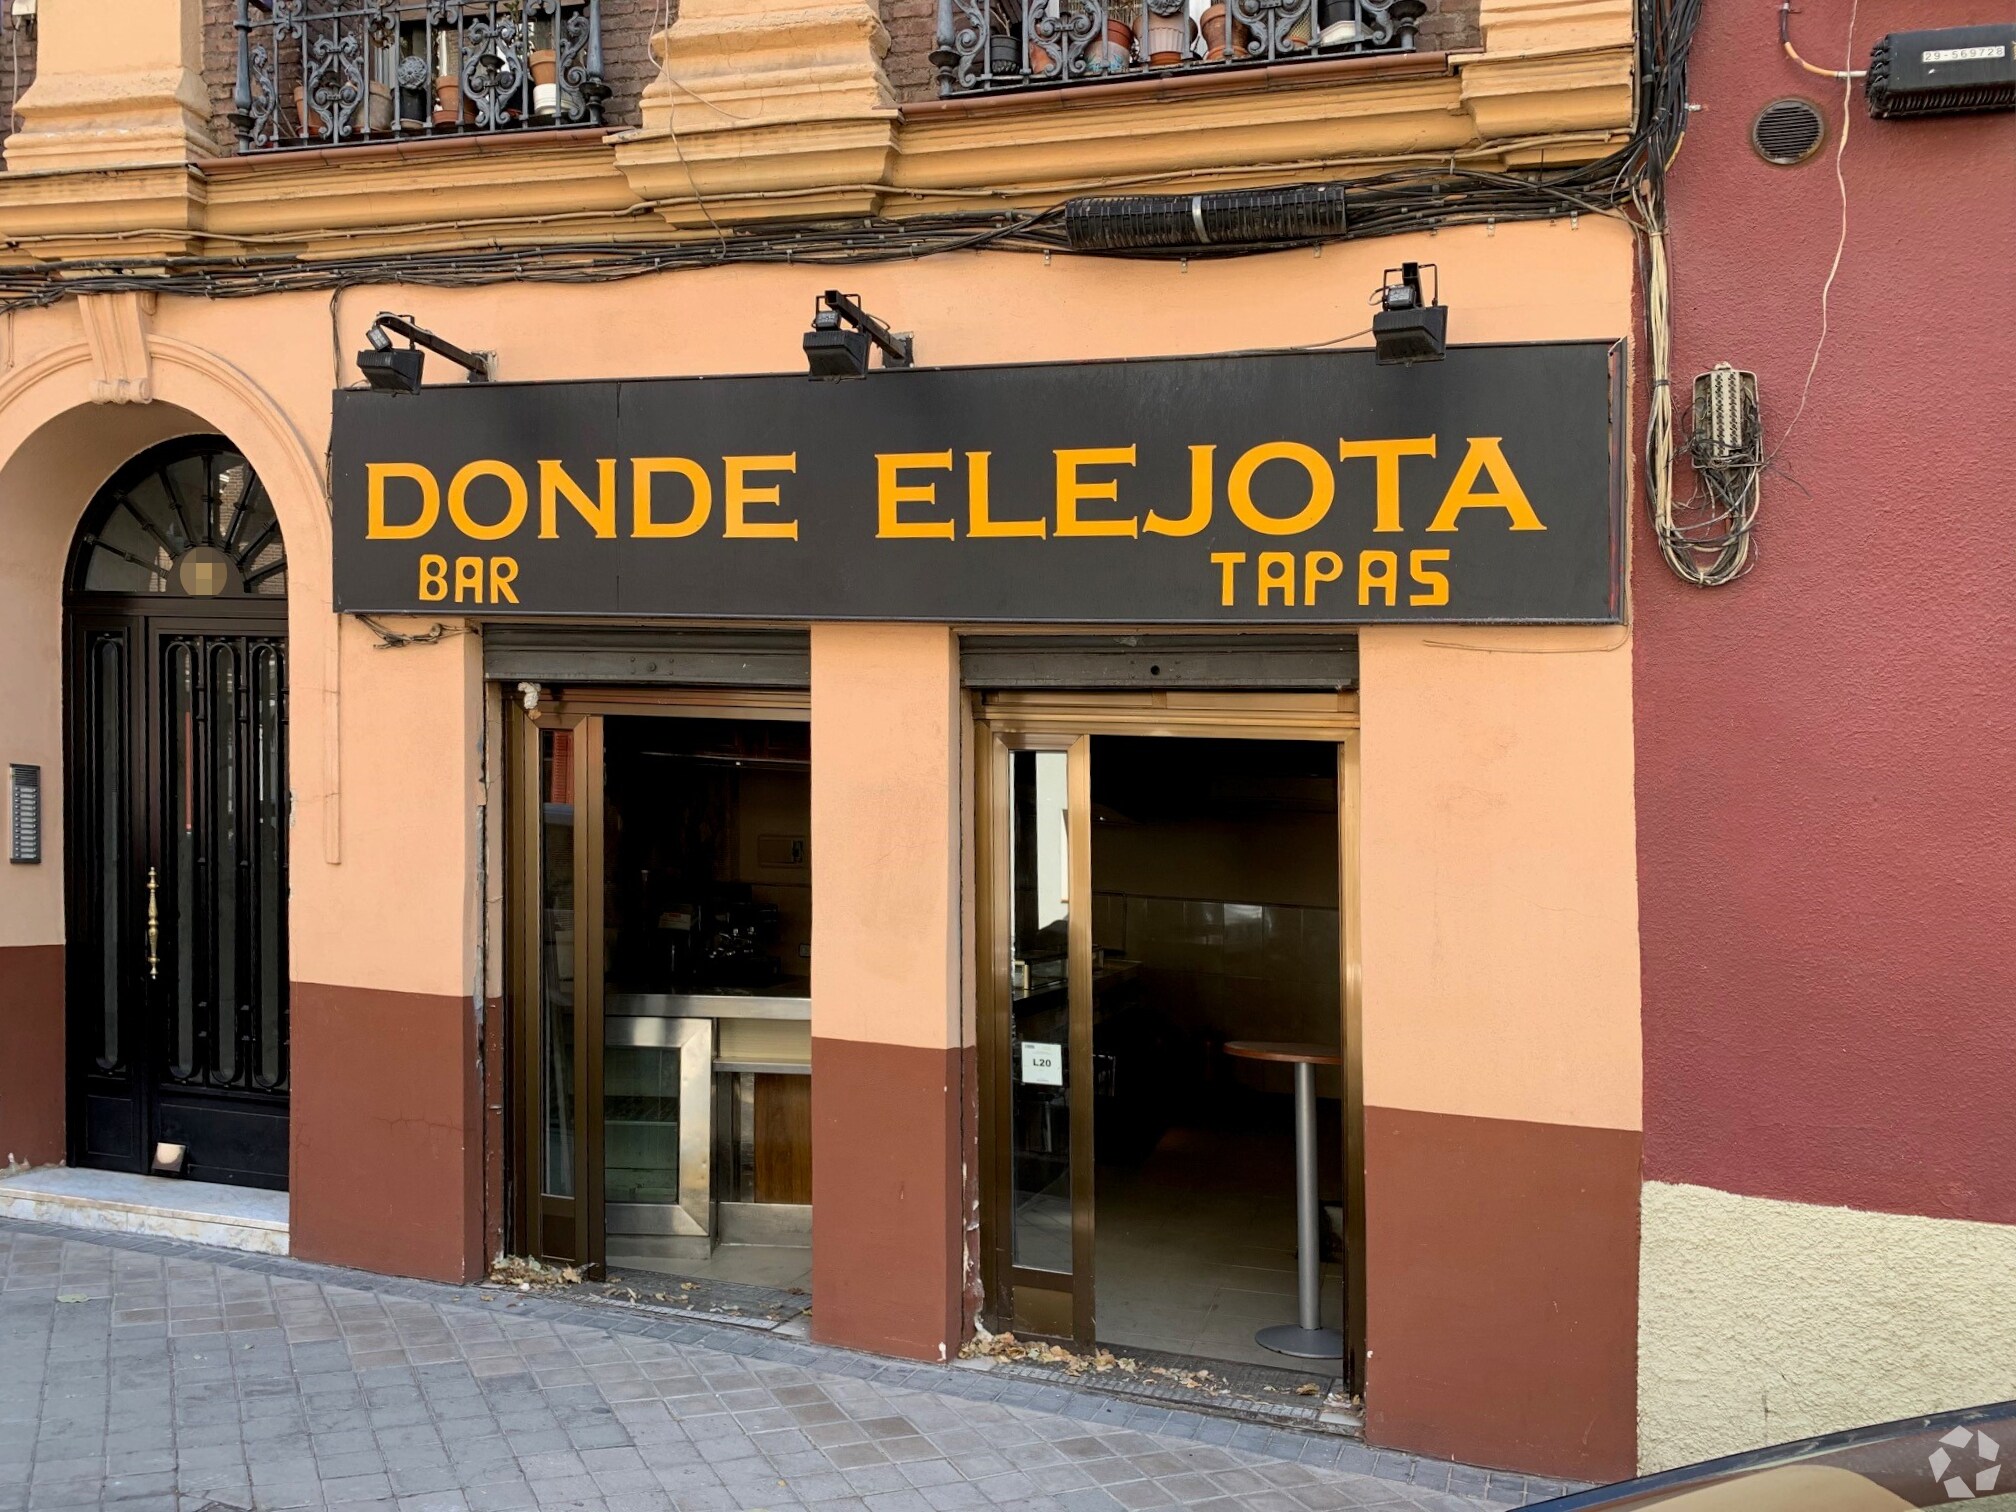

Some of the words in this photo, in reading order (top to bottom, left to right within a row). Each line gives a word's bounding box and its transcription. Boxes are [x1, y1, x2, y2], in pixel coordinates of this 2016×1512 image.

[1924, 47, 2004, 61] 29-569728
[366, 452, 800, 541] DONDE
[875, 436, 1547, 540] ELEJOTA
[418, 553, 519, 604] BAR
[1210, 548, 1451, 607] TAPAS
[1032, 1058, 1052, 1068] L20
